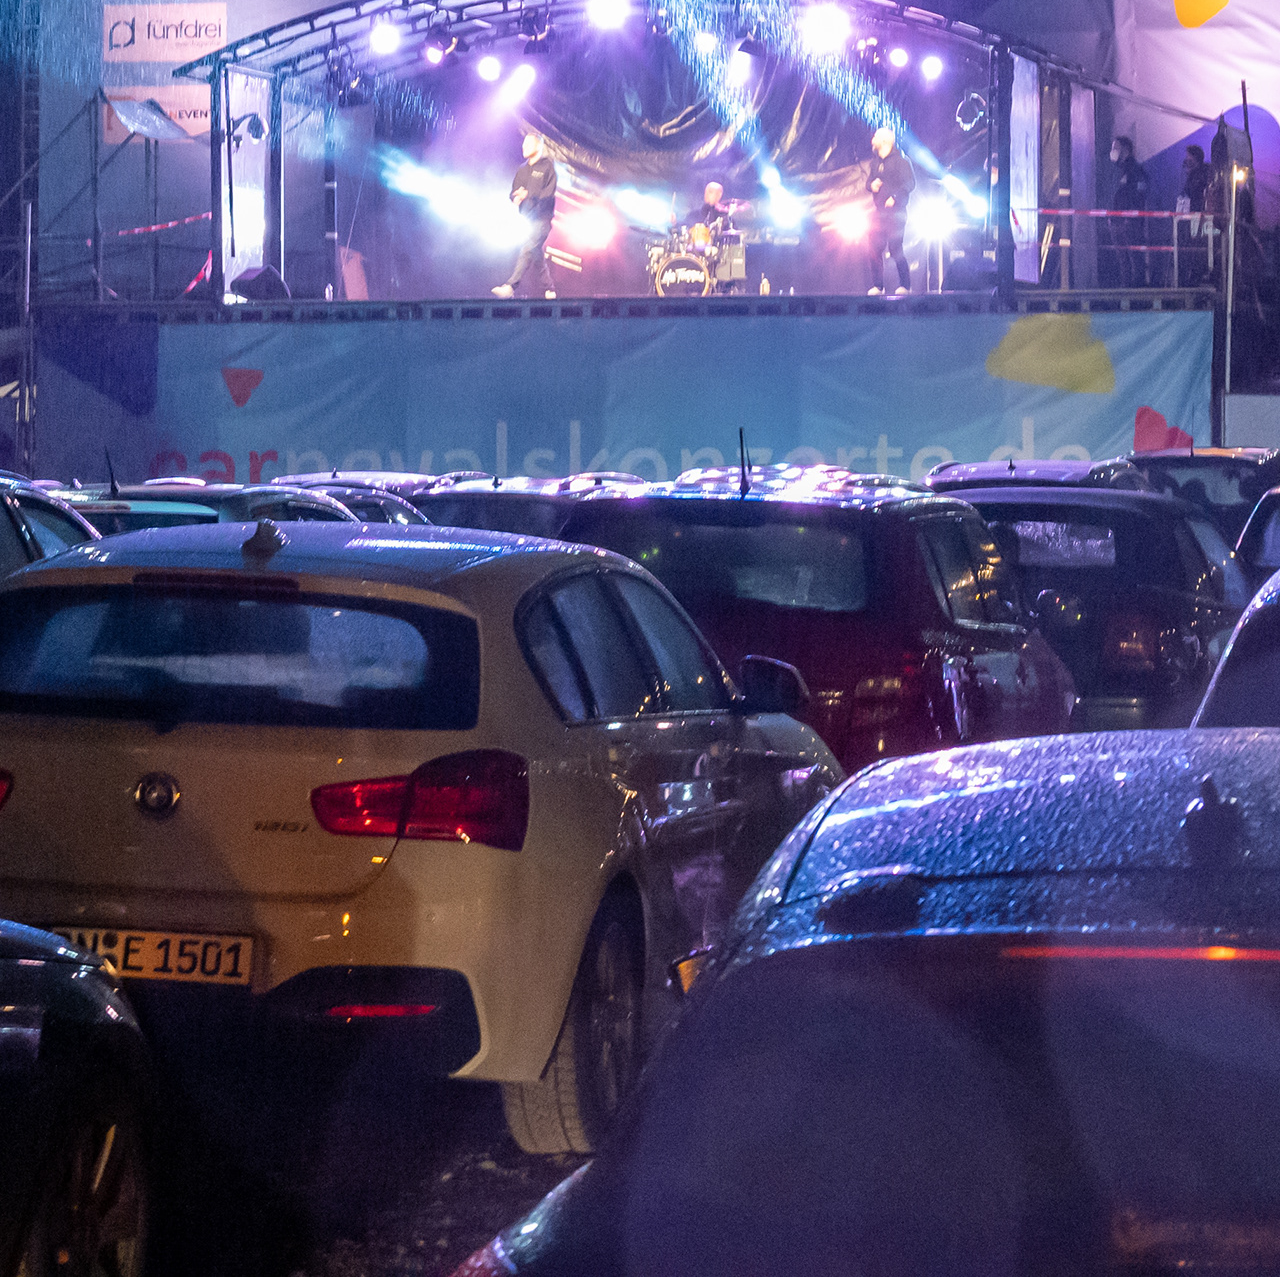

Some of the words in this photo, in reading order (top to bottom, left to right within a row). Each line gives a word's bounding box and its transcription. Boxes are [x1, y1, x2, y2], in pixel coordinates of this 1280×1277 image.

[146, 19, 222, 40] fünfdrei
[122, 935, 145, 971] E
[154, 937, 244, 978] 1501
